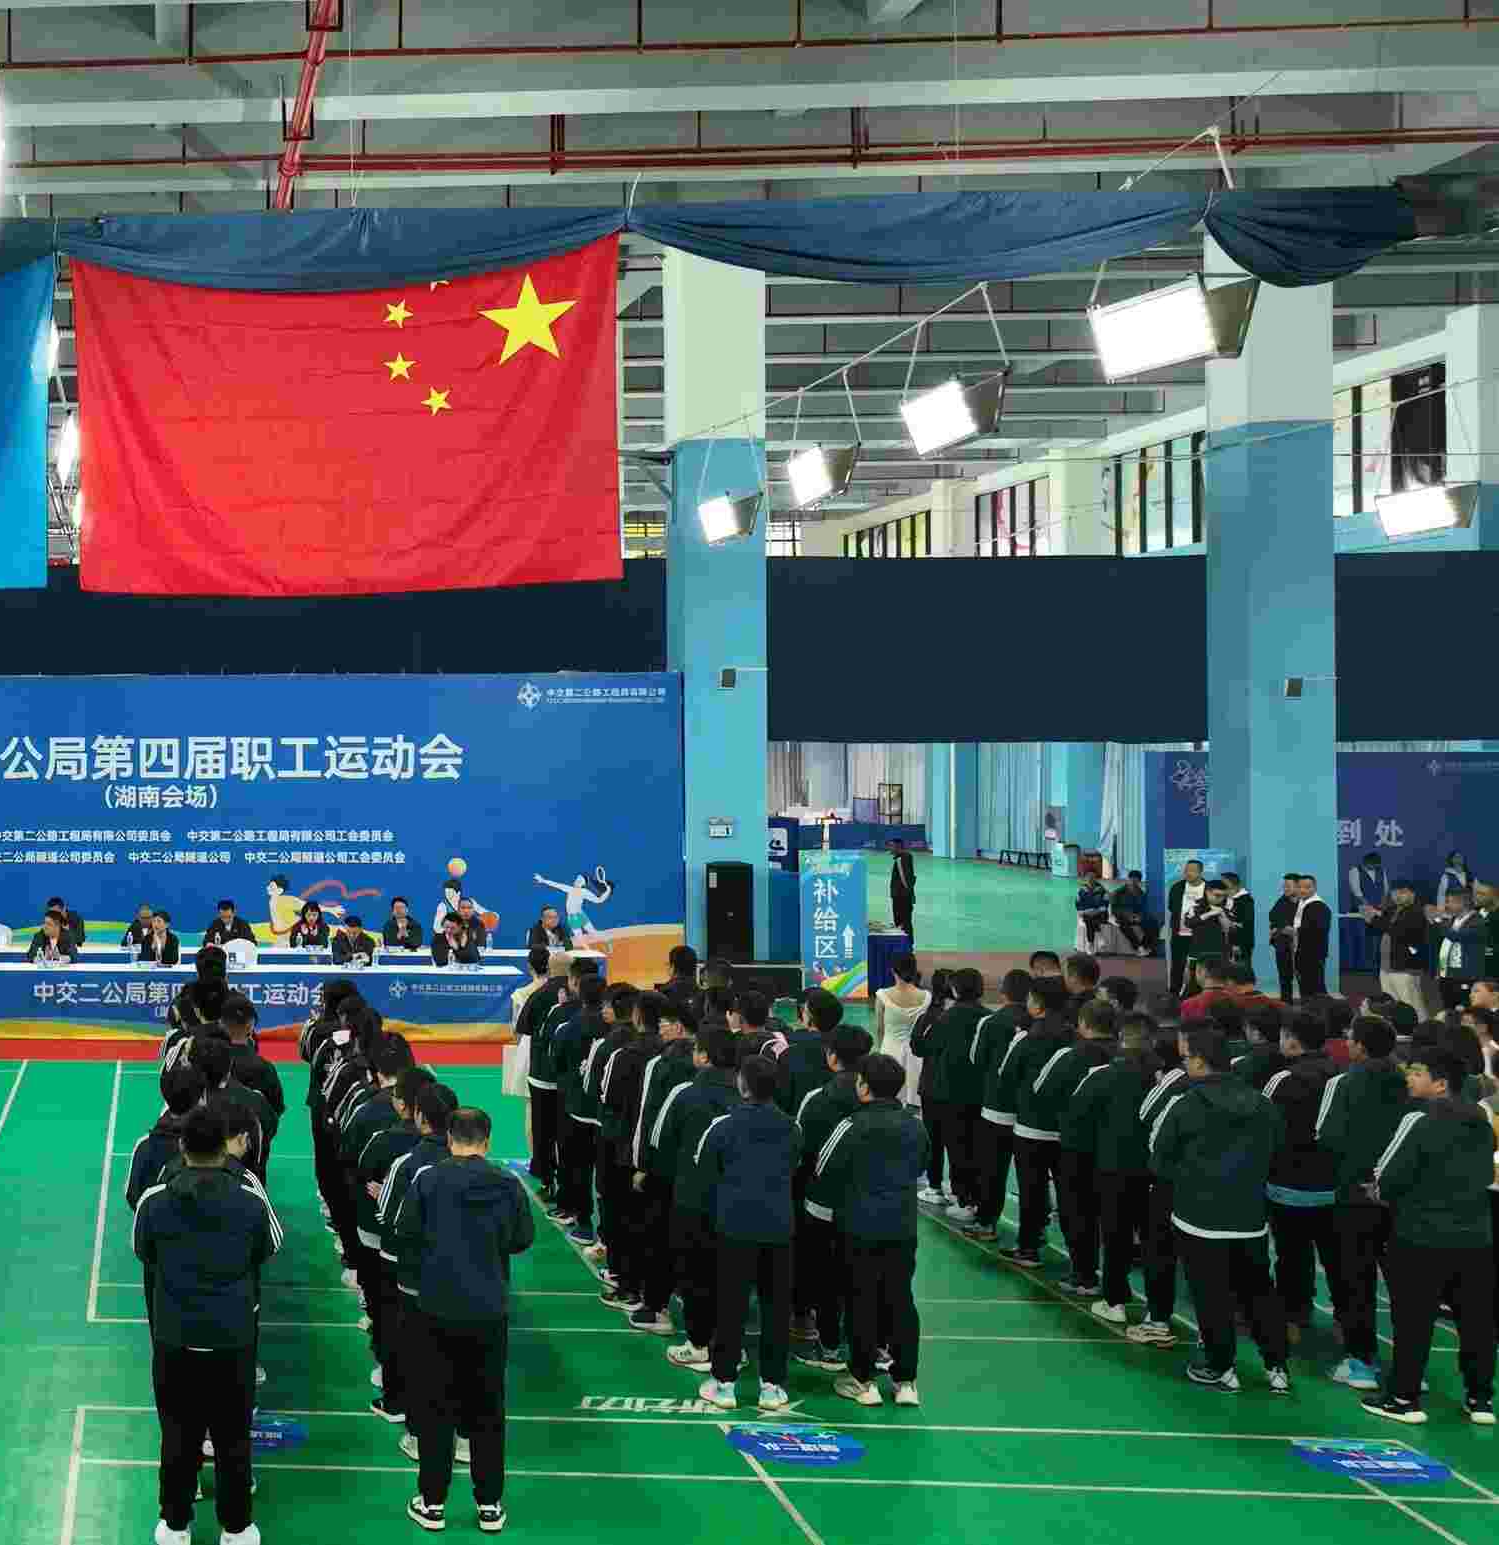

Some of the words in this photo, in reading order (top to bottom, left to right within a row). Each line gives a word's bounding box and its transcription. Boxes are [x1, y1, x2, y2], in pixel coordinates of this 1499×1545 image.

[105, 785, 219, 810] （湖南会场）
[813, 879, 838, 958] 补给区
[33, 980, 325, 1004] 中交二公局第四工运动会
